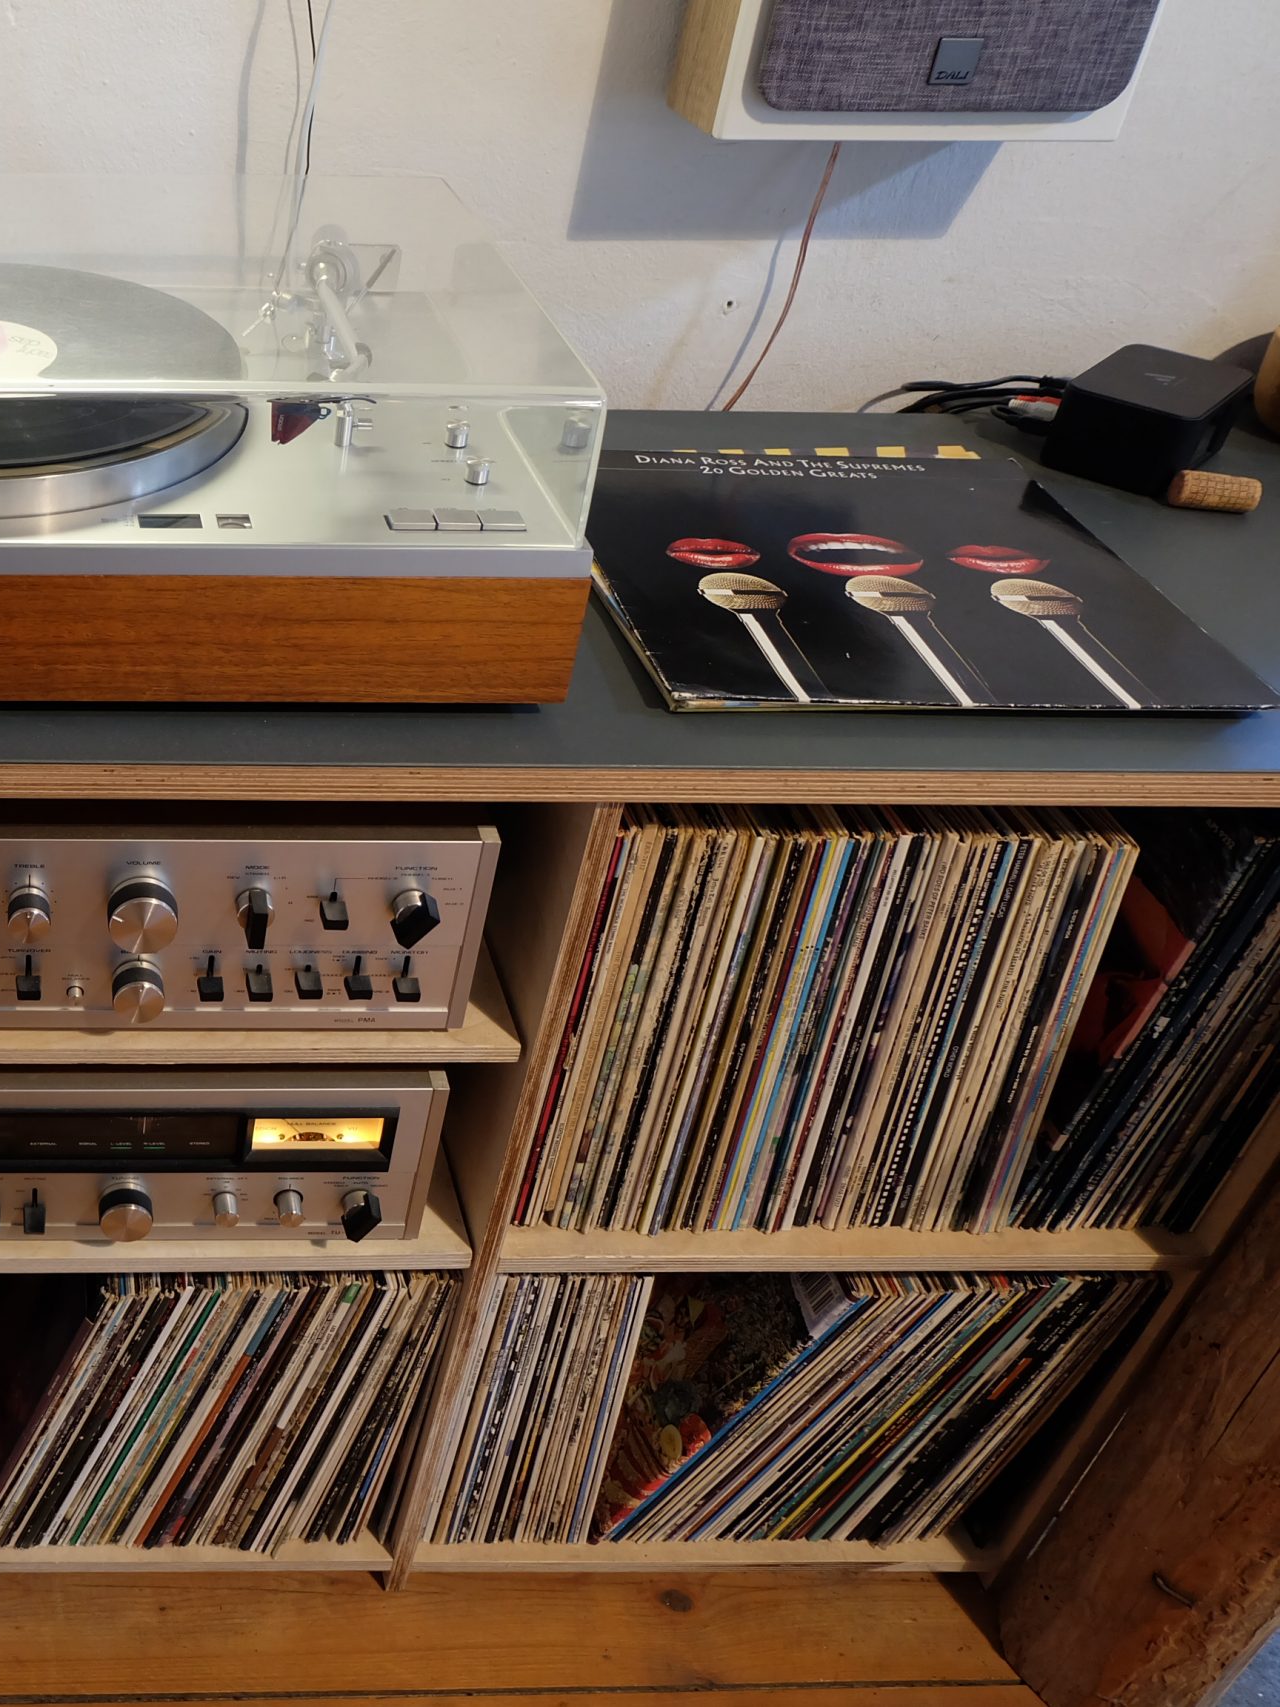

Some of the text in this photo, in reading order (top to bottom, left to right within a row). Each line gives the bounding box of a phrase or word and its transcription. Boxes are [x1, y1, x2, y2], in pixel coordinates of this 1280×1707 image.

[935, 70, 970, 80] DALI
[634, 455, 926, 472] DIANA ROSS AND THE SUPREMES
[699, 466, 878, 479] 20 GOLDEN GREATS
[1016, 842, 1027, 860] PETER
[1008, 858, 1022, 884] HAMMILL
[917, 860, 948, 940] TWO SIDES OF PETER BANKS
[1002, 886, 1012, 901] GARY
[996, 900, 1007, 919] LUCAS
[942, 1044, 959, 1079] OTHER WORLD
